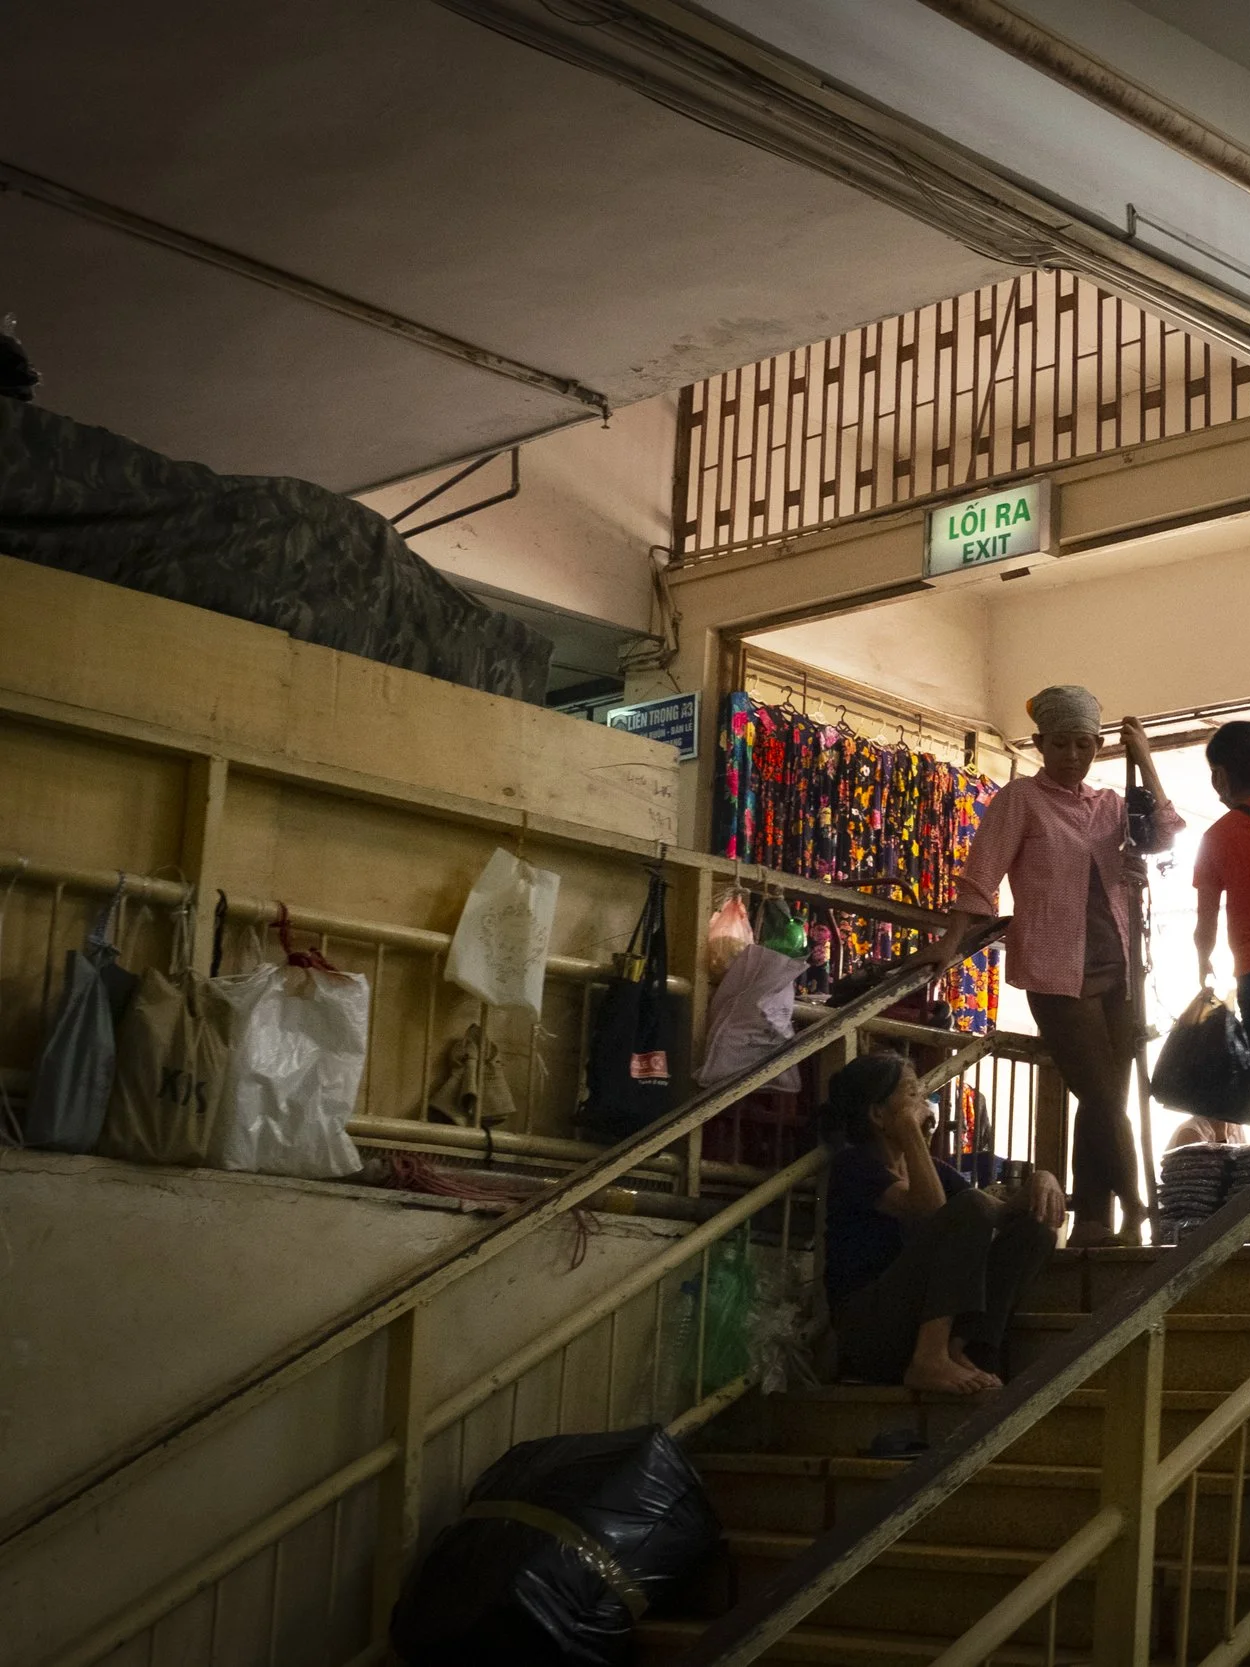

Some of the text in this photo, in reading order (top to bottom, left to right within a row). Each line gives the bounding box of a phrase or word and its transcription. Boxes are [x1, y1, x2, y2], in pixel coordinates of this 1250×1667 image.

[949, 498, 1031, 540] LỐI RA
[962, 533, 1011, 564] EXIT
